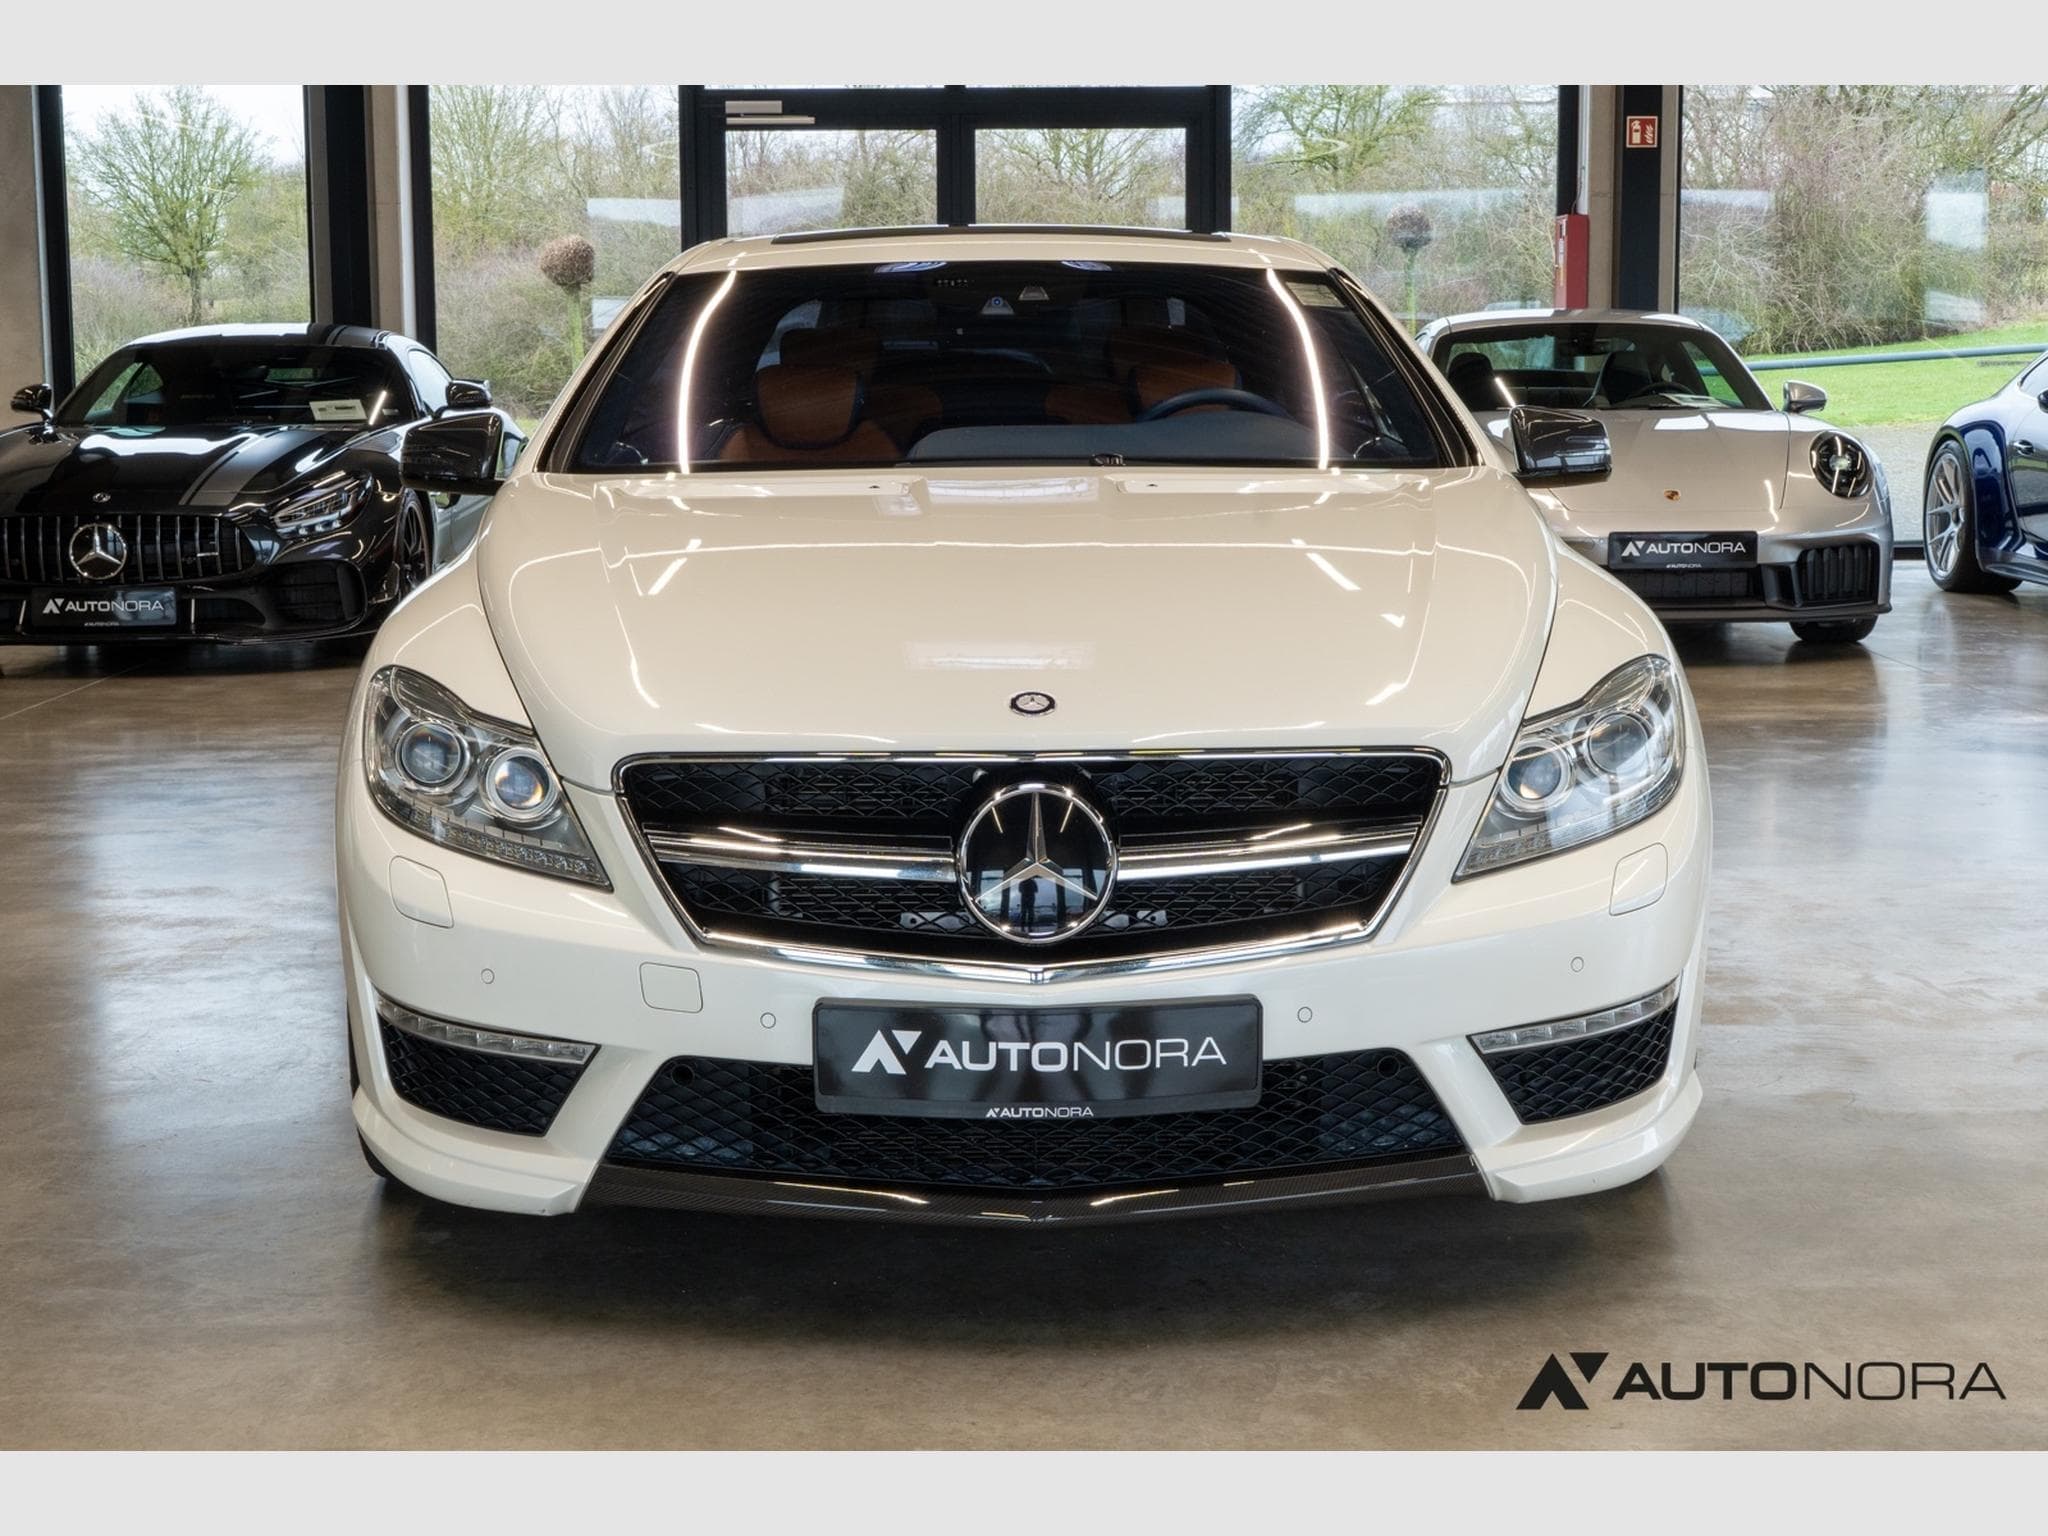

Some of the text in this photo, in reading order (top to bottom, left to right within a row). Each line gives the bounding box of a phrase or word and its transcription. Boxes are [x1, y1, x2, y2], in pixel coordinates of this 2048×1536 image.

[1645, 541, 1746, 554] AUTONORA
[64, 600, 164, 612] AUTONORA
[924, 1036, 1228, 1072] AUTONORA
[999, 1106, 1094, 1118] AUTONORA
